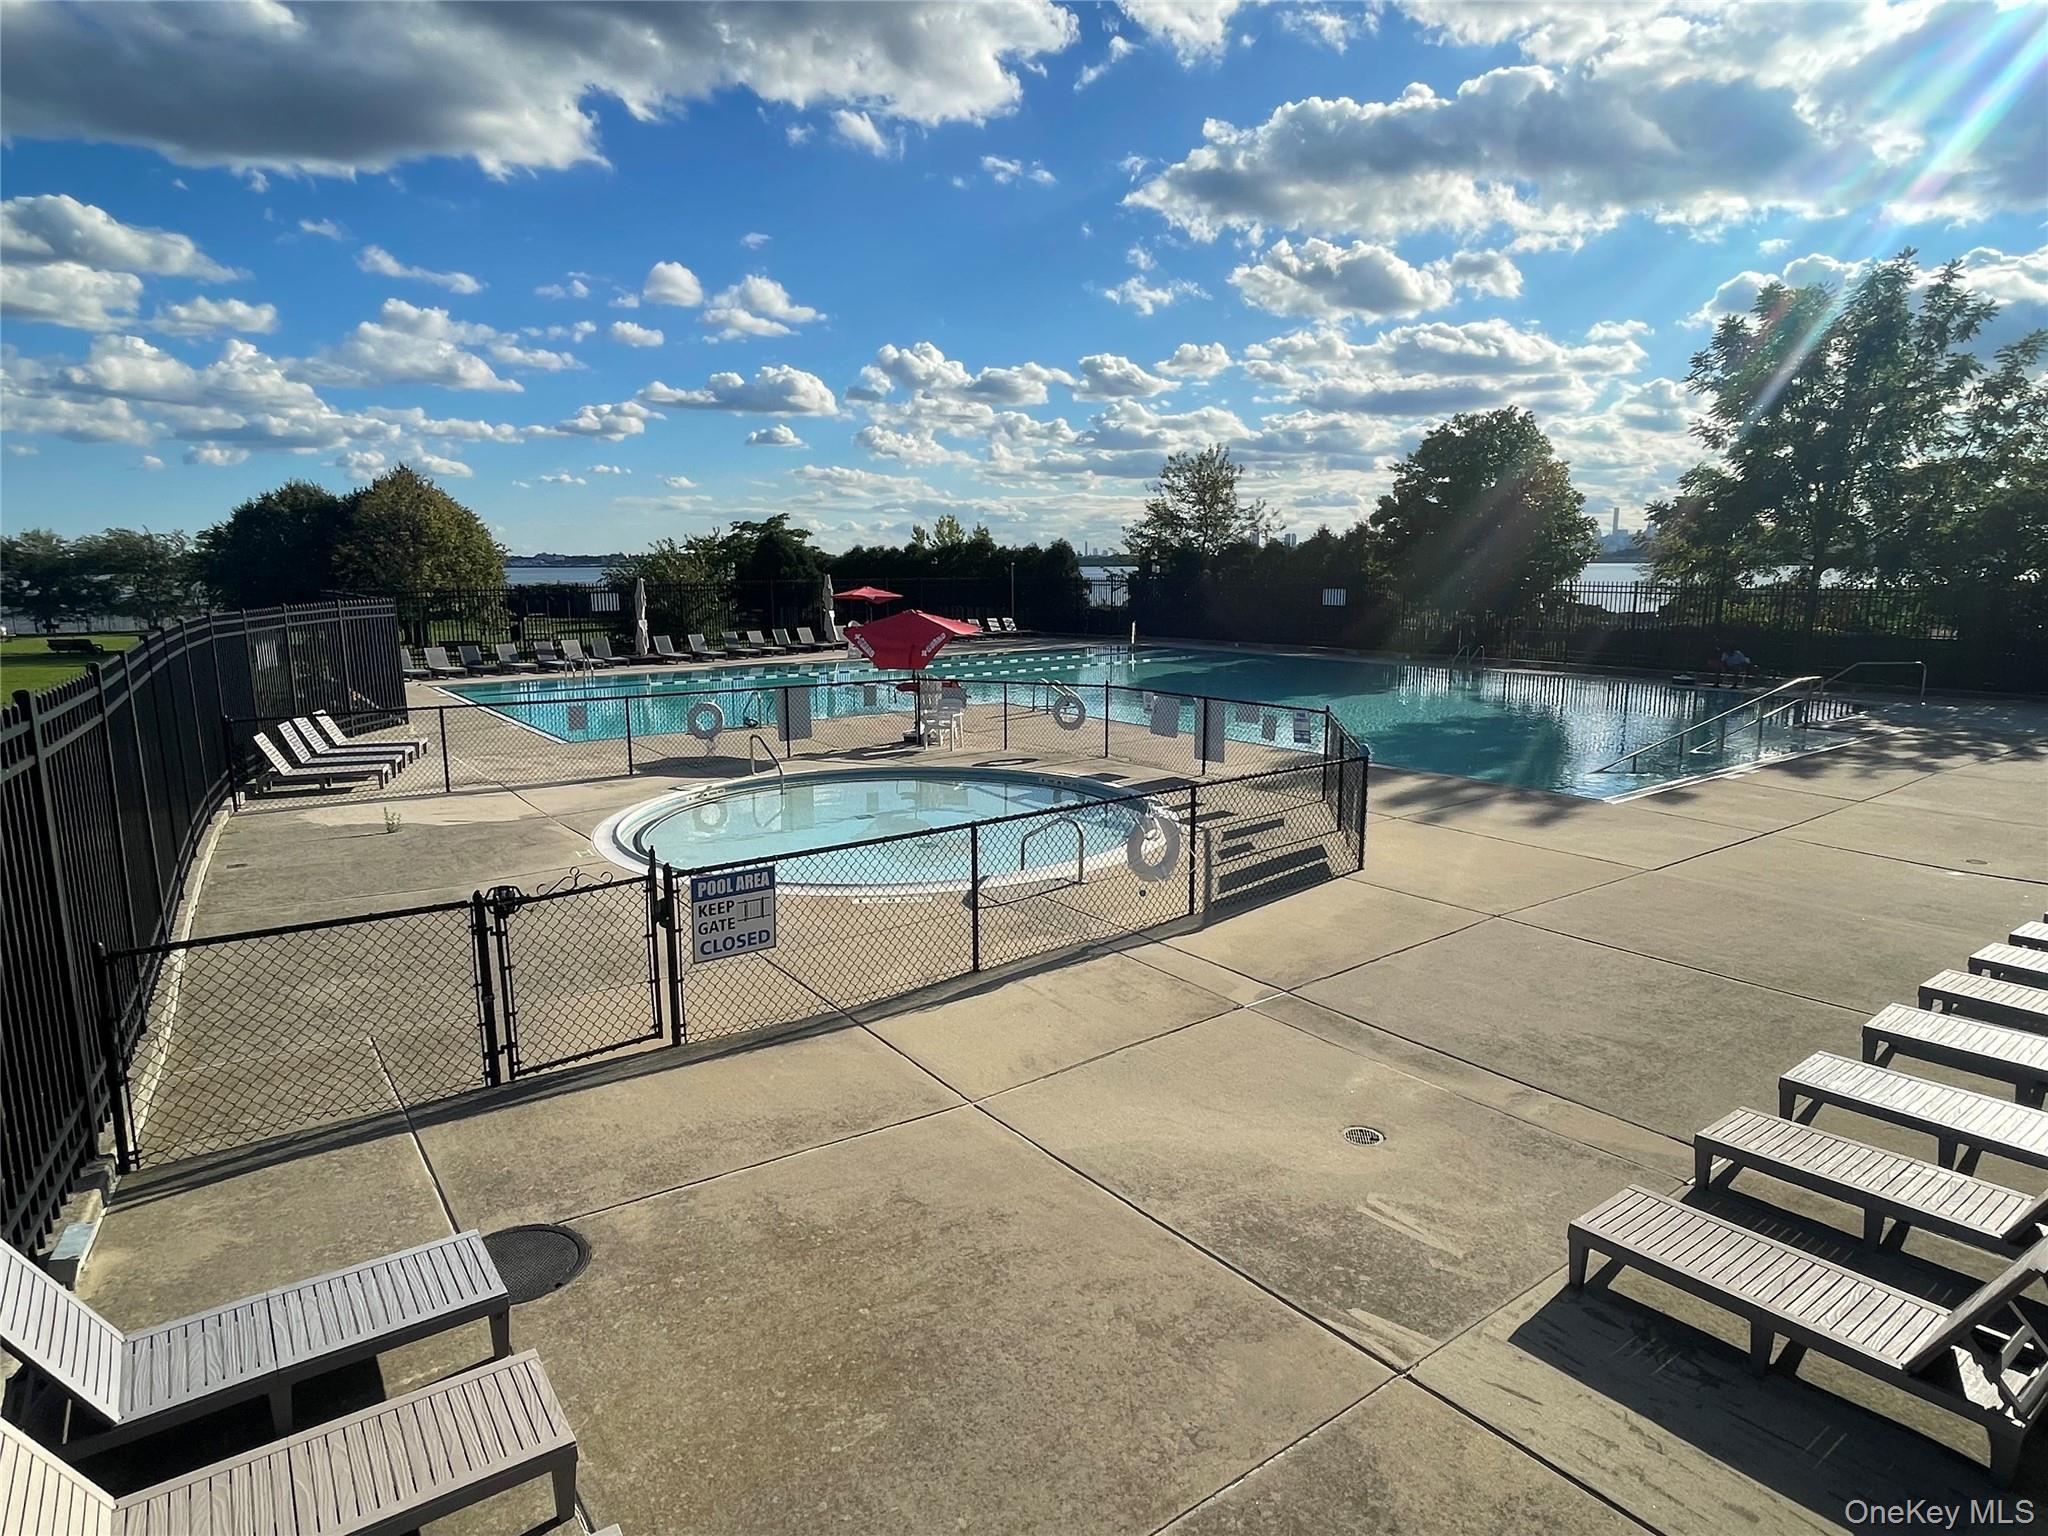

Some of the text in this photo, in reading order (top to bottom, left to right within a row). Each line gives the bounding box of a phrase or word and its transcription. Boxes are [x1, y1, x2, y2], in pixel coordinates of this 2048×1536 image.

[697, 872, 770, 898] POOL AREA
[698, 900, 735, 918] KEEP
[698, 917, 736, 935] GATE
[700, 929, 771, 956] CLOSED
